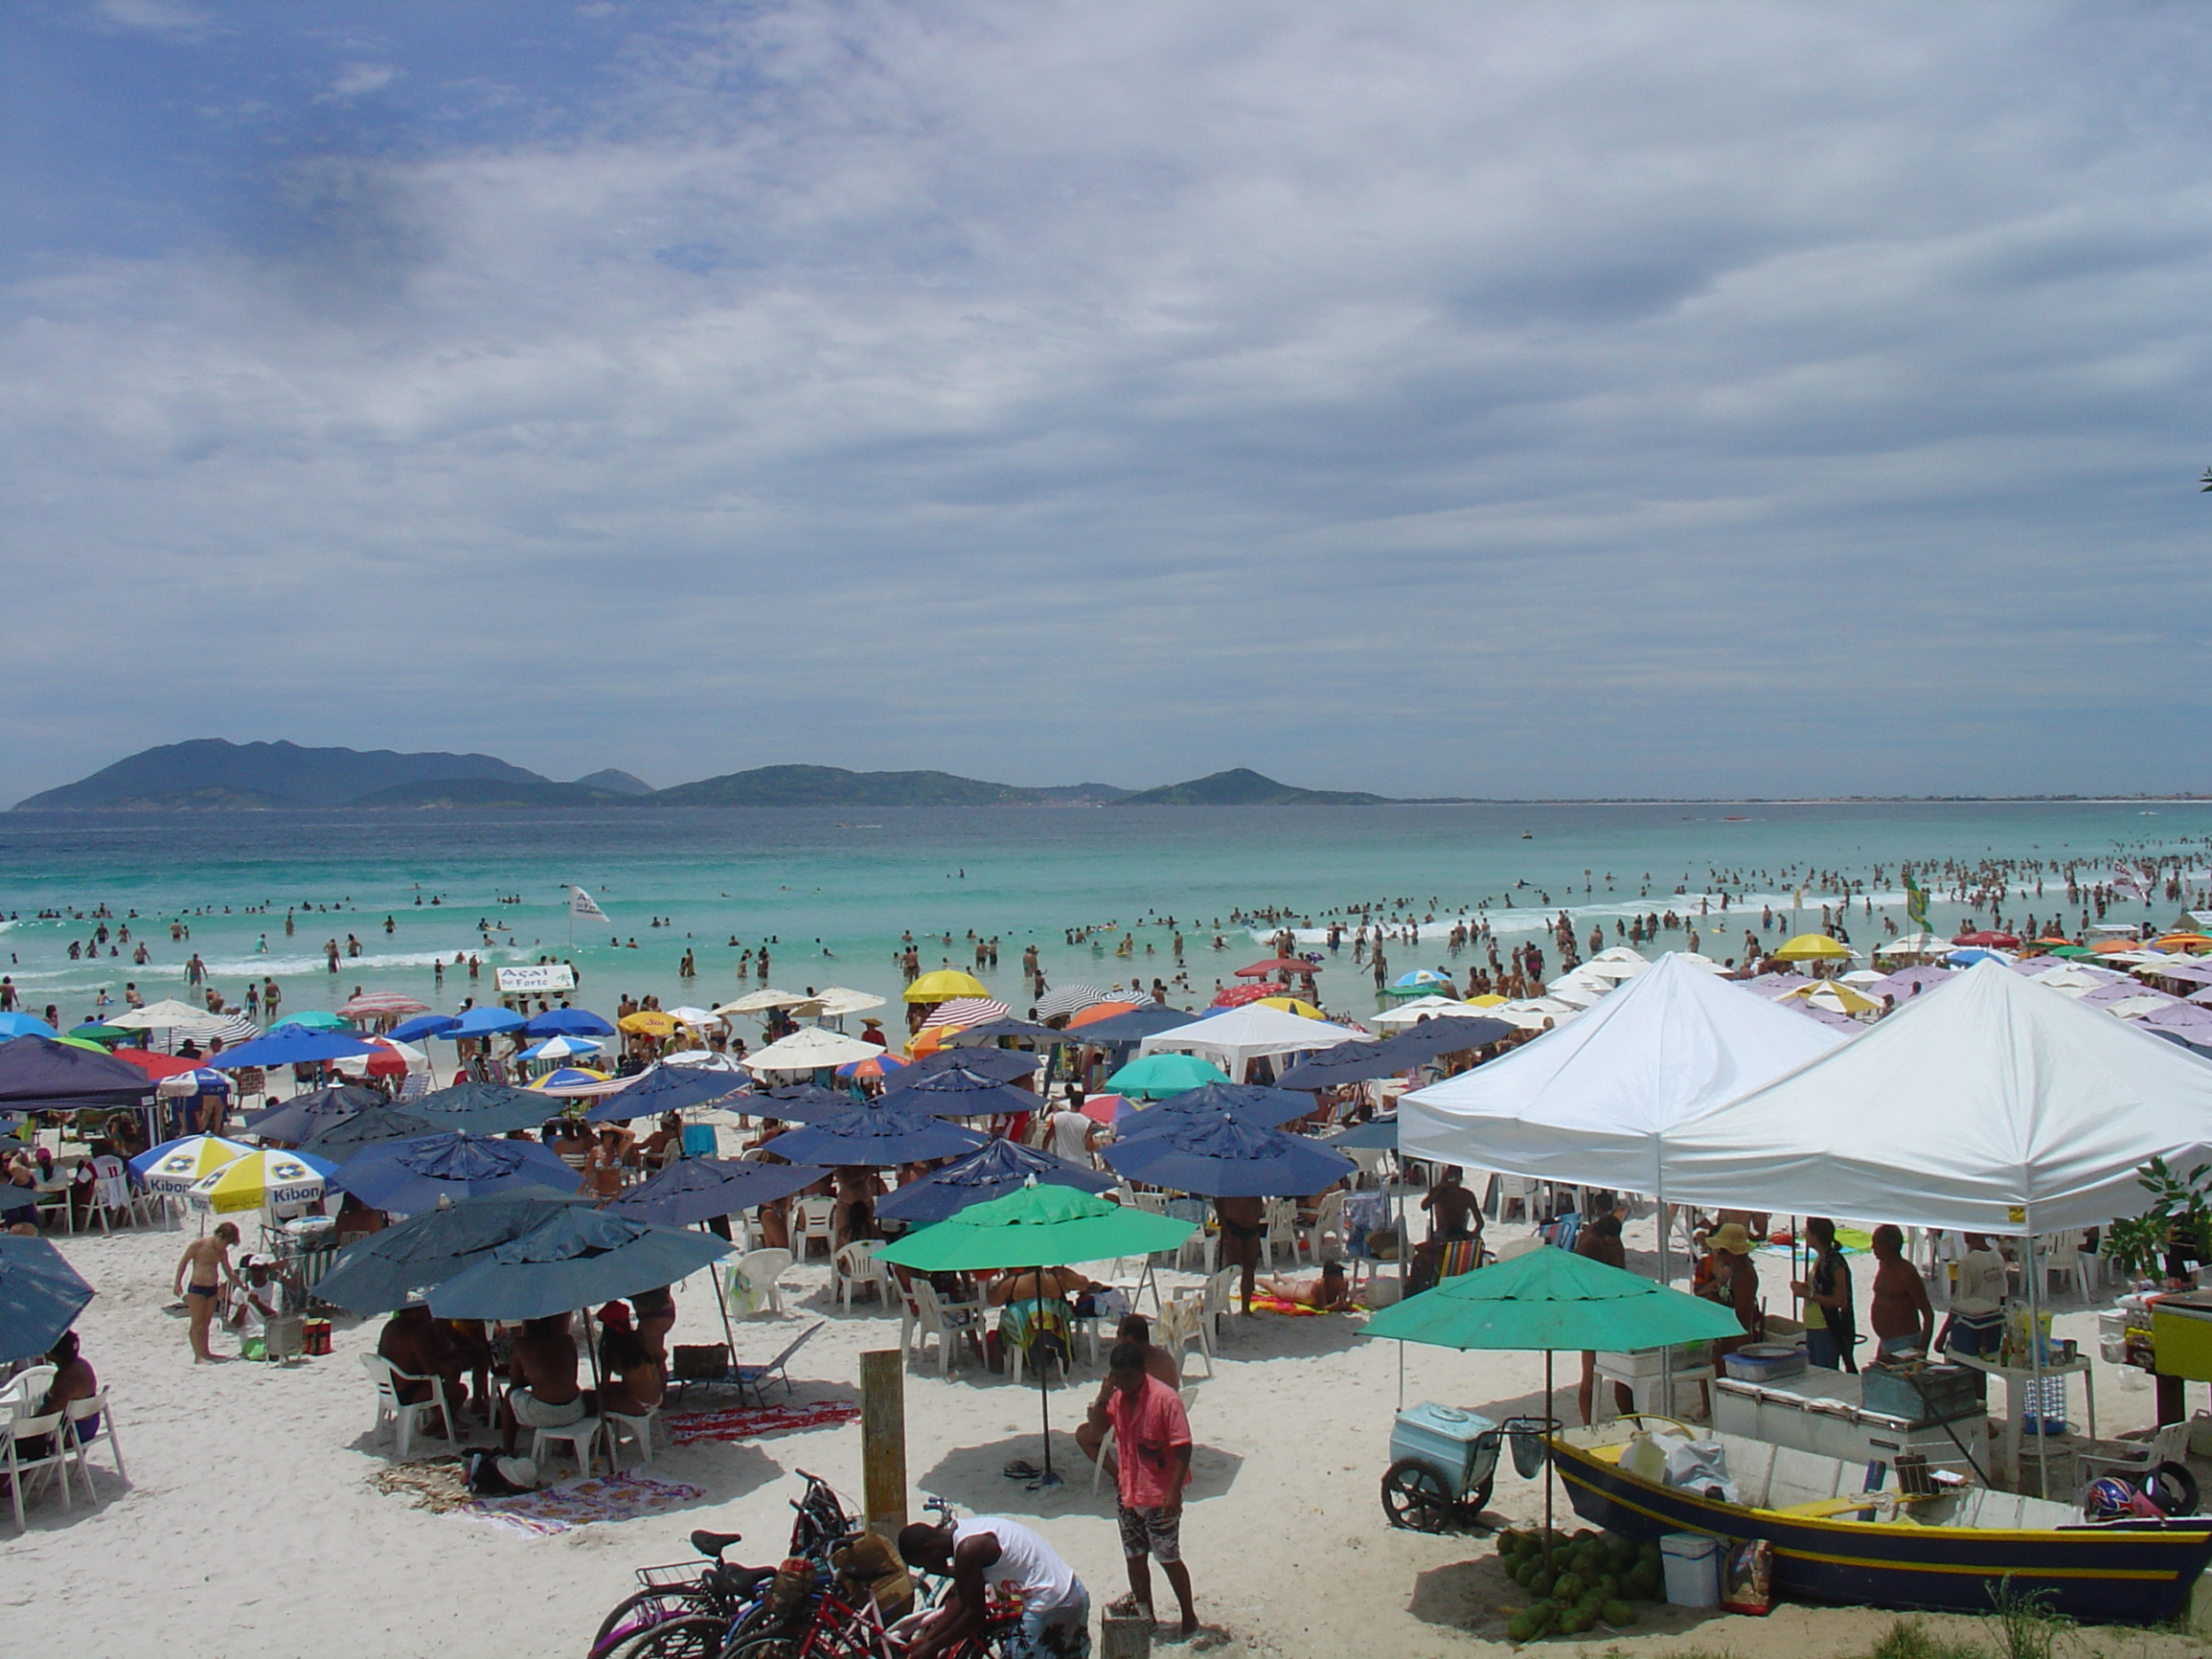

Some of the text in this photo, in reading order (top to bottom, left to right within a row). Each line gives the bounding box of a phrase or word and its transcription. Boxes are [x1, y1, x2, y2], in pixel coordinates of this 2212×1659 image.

[107, 1166, 118, 1178] 11
[150, 1179, 191, 1193] Kibon
[274, 1187, 319, 1203] Kibon
